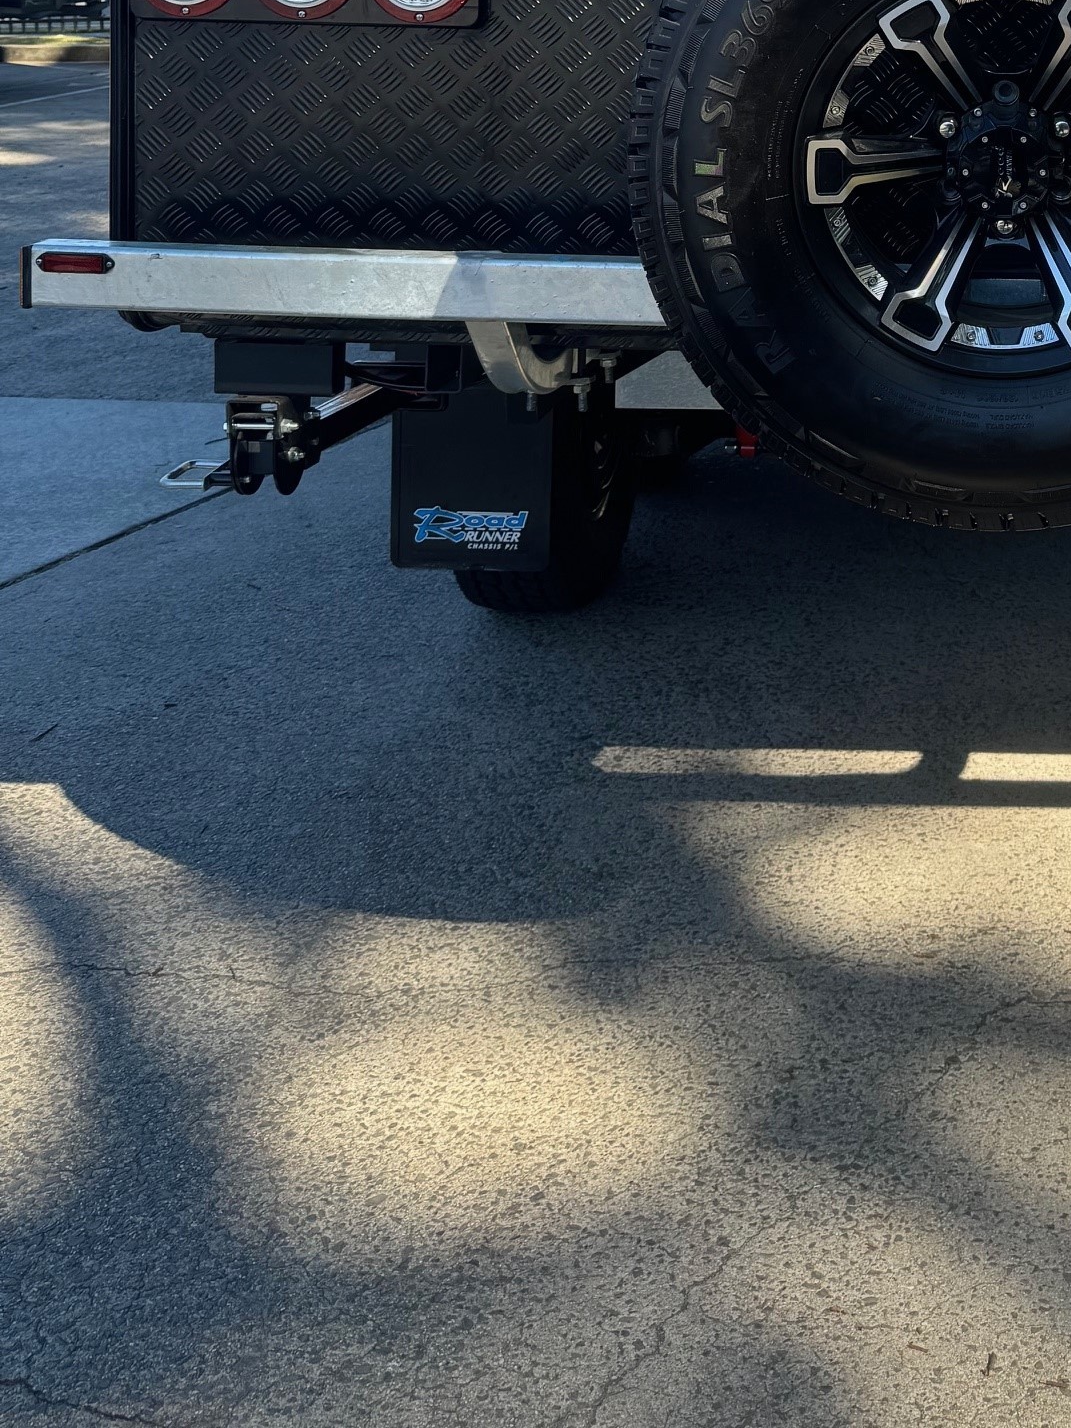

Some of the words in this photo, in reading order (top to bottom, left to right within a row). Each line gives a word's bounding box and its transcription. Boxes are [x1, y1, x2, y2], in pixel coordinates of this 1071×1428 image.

[691, 147, 798, 376] RADIAL
[413, 505, 529, 543] Road
[464, 531, 521, 543] RUNNER
[467, 542, 502, 550] CHASSIS
